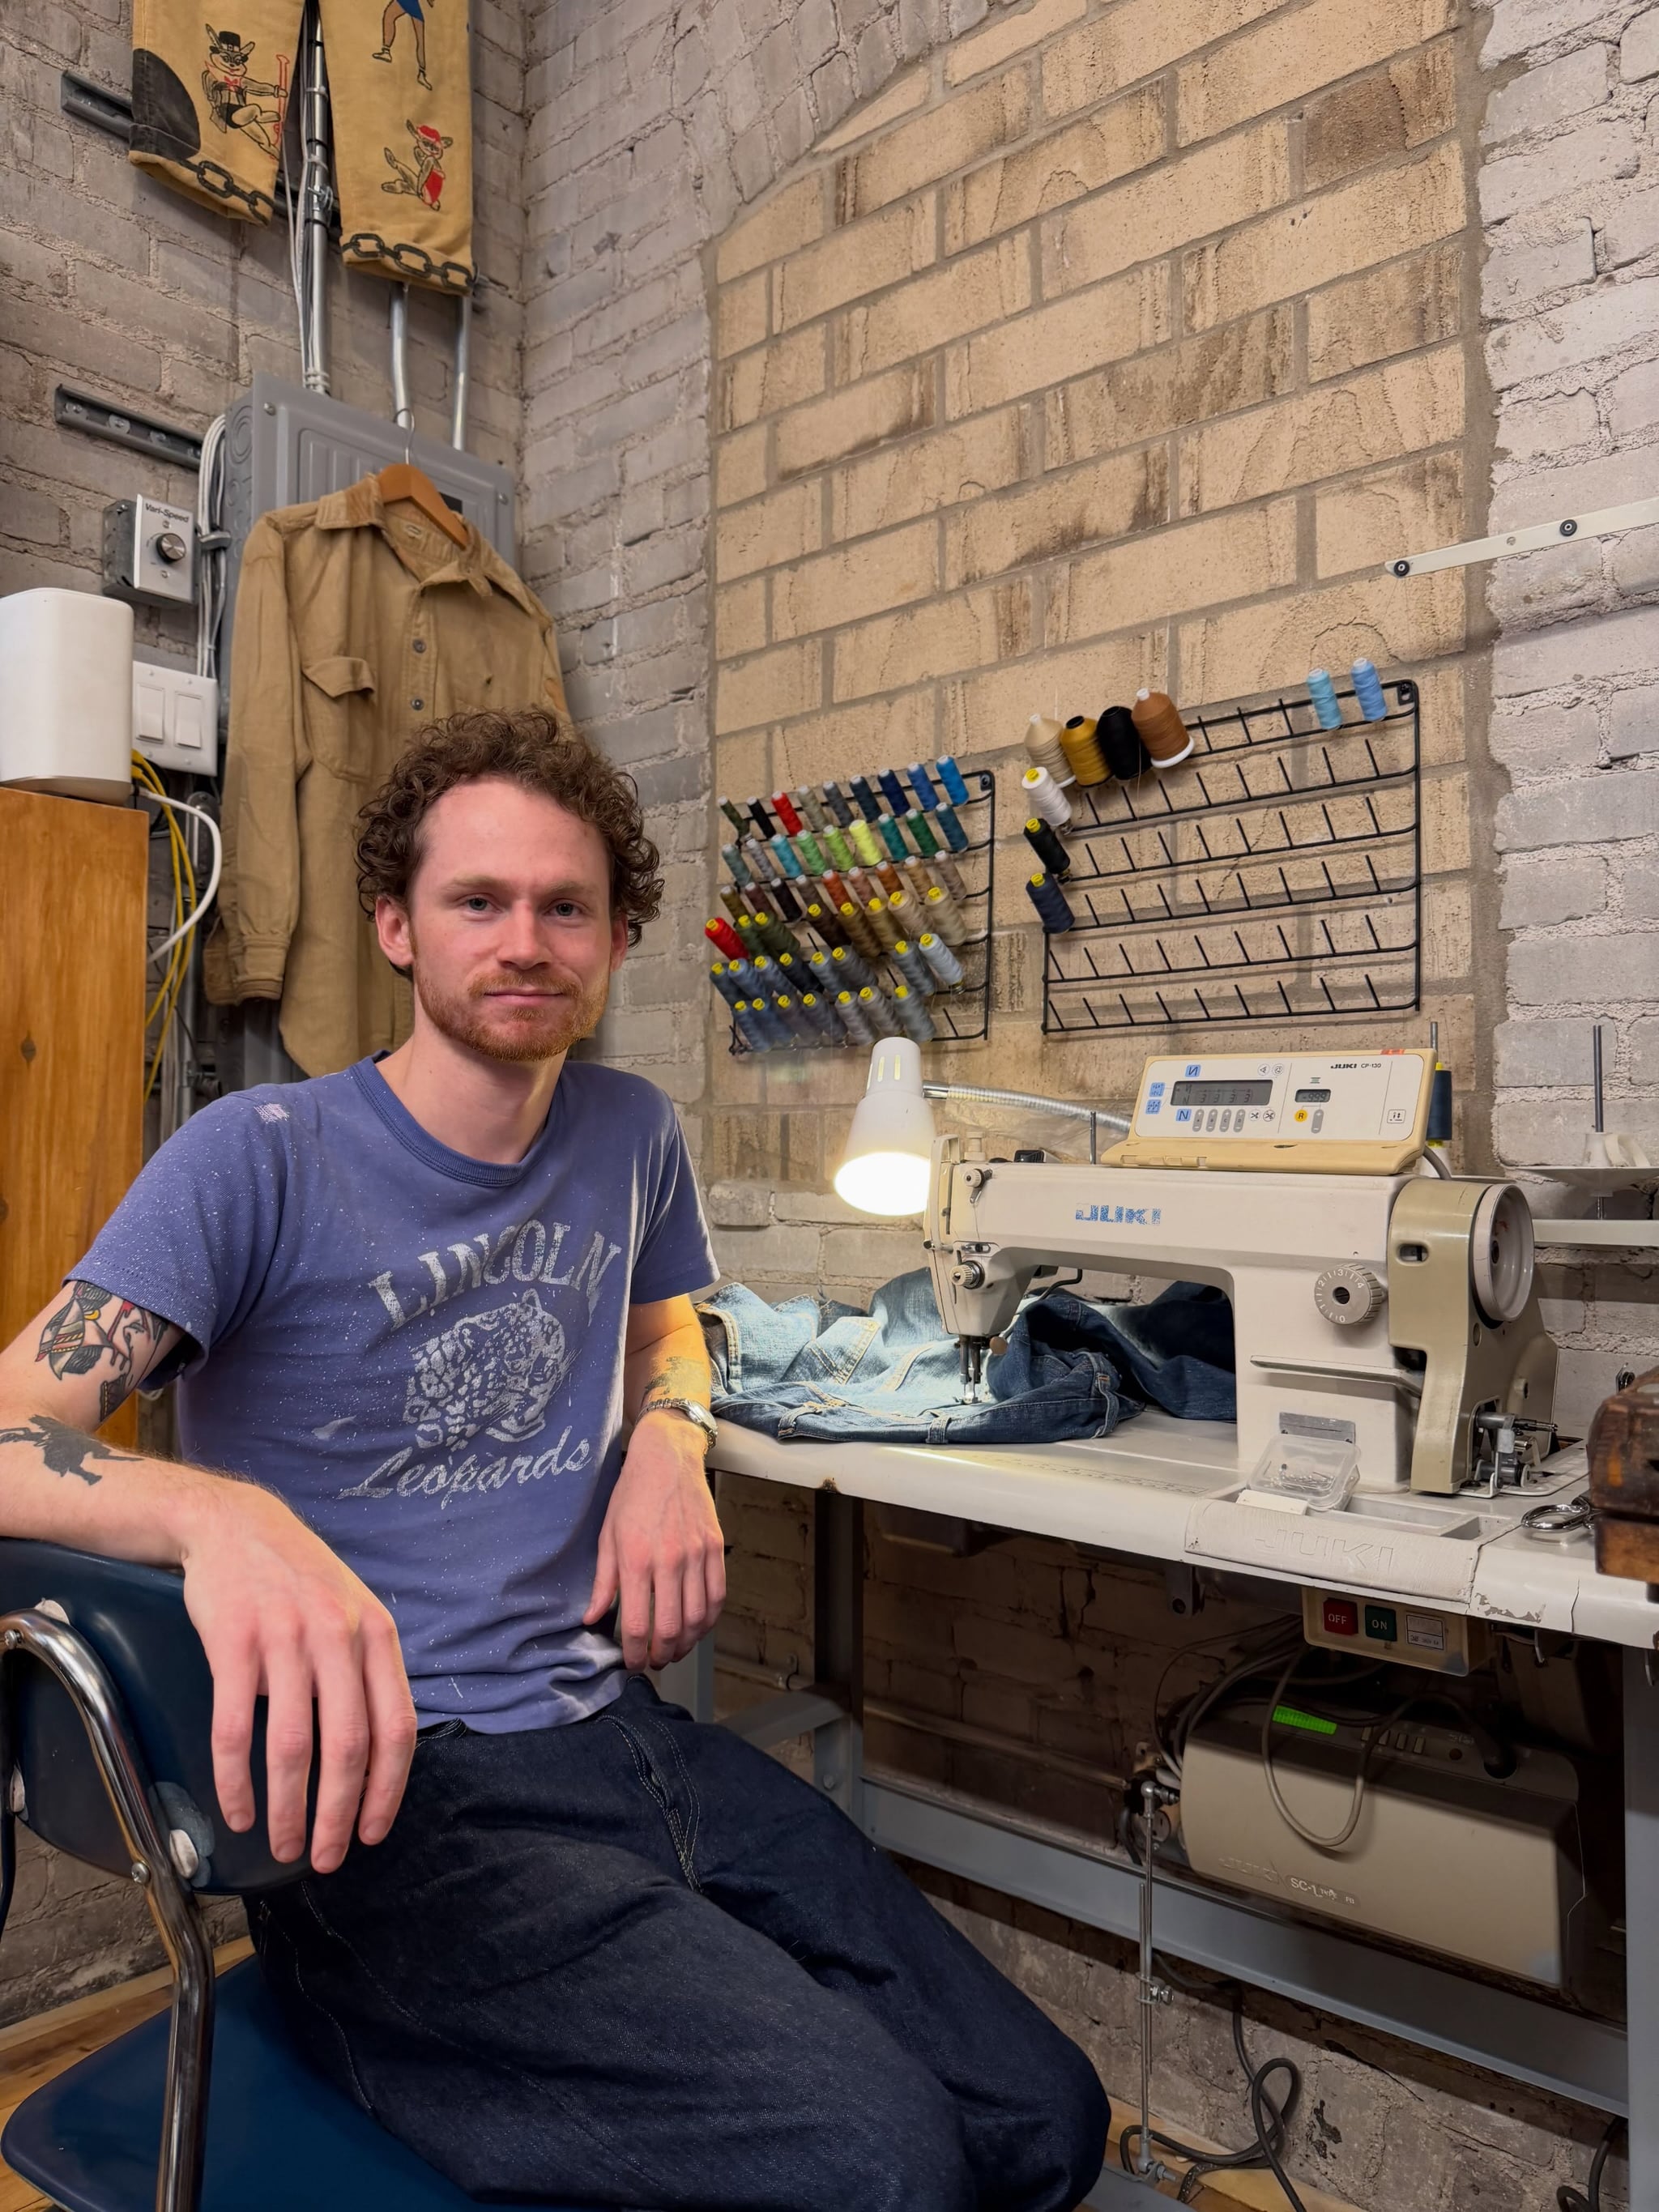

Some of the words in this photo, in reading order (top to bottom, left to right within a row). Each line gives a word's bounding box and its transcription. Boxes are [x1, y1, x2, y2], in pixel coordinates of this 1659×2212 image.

[145, 503, 190, 523] Vari-Speed
[1075, 1204, 1162, 1225] JUKI
[368, 1219, 622, 1332] LINCOLN
[1337, 1268, 1343, 1276] 3
[336, 1424, 593, 1510] Leopards
[1328, 1613, 1348, 1625] OFF
[1371, 1618, 1388, 1630] ON
